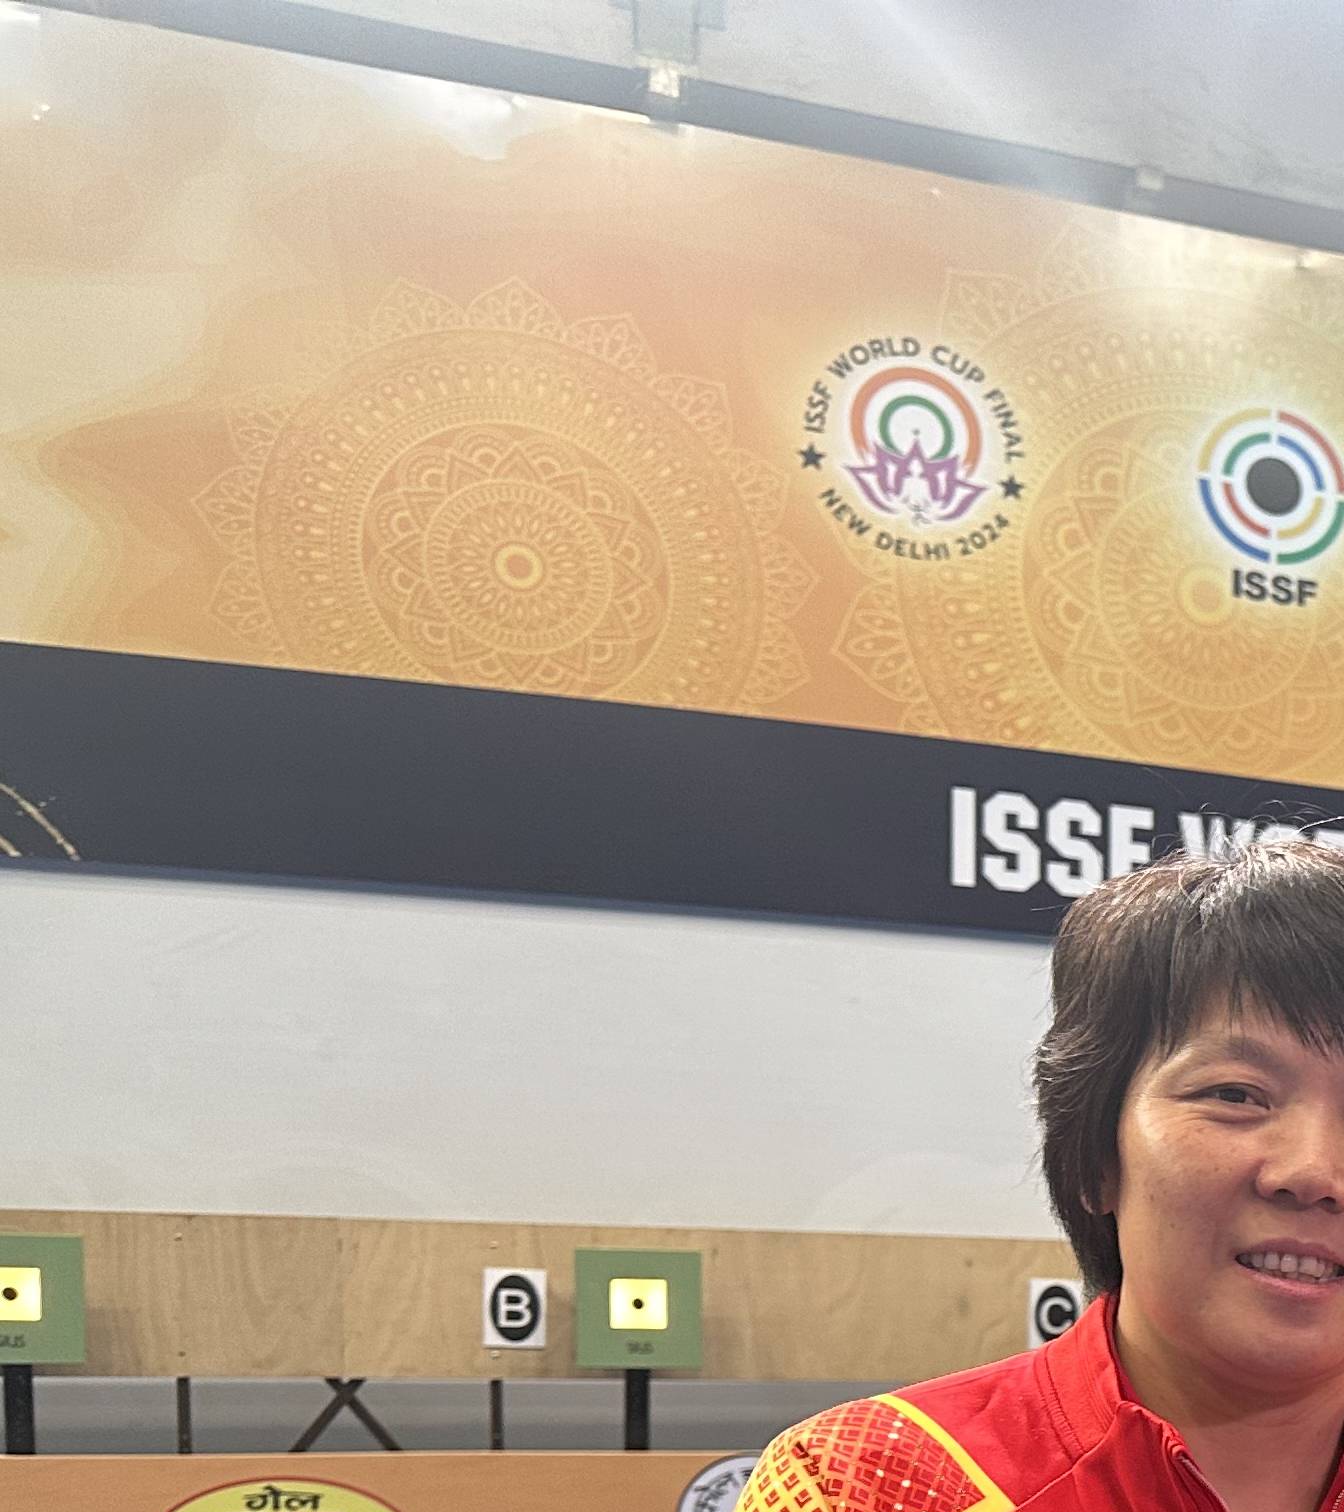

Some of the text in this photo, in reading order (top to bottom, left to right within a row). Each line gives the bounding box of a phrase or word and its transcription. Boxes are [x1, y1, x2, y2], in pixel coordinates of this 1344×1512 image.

[804, 337, 1025, 461] ISSF WORLD CUP FINAL
[819, 488, 1010, 561] NEW DELHI 2024
[1232, 569, 1318, 607] ISSF
[950, 786, 1155, 898] ISSF
[498, 1287, 532, 1328] B
[1040, 1296, 1073, 1335] C
[243, 1485, 324, 1512] गेल
